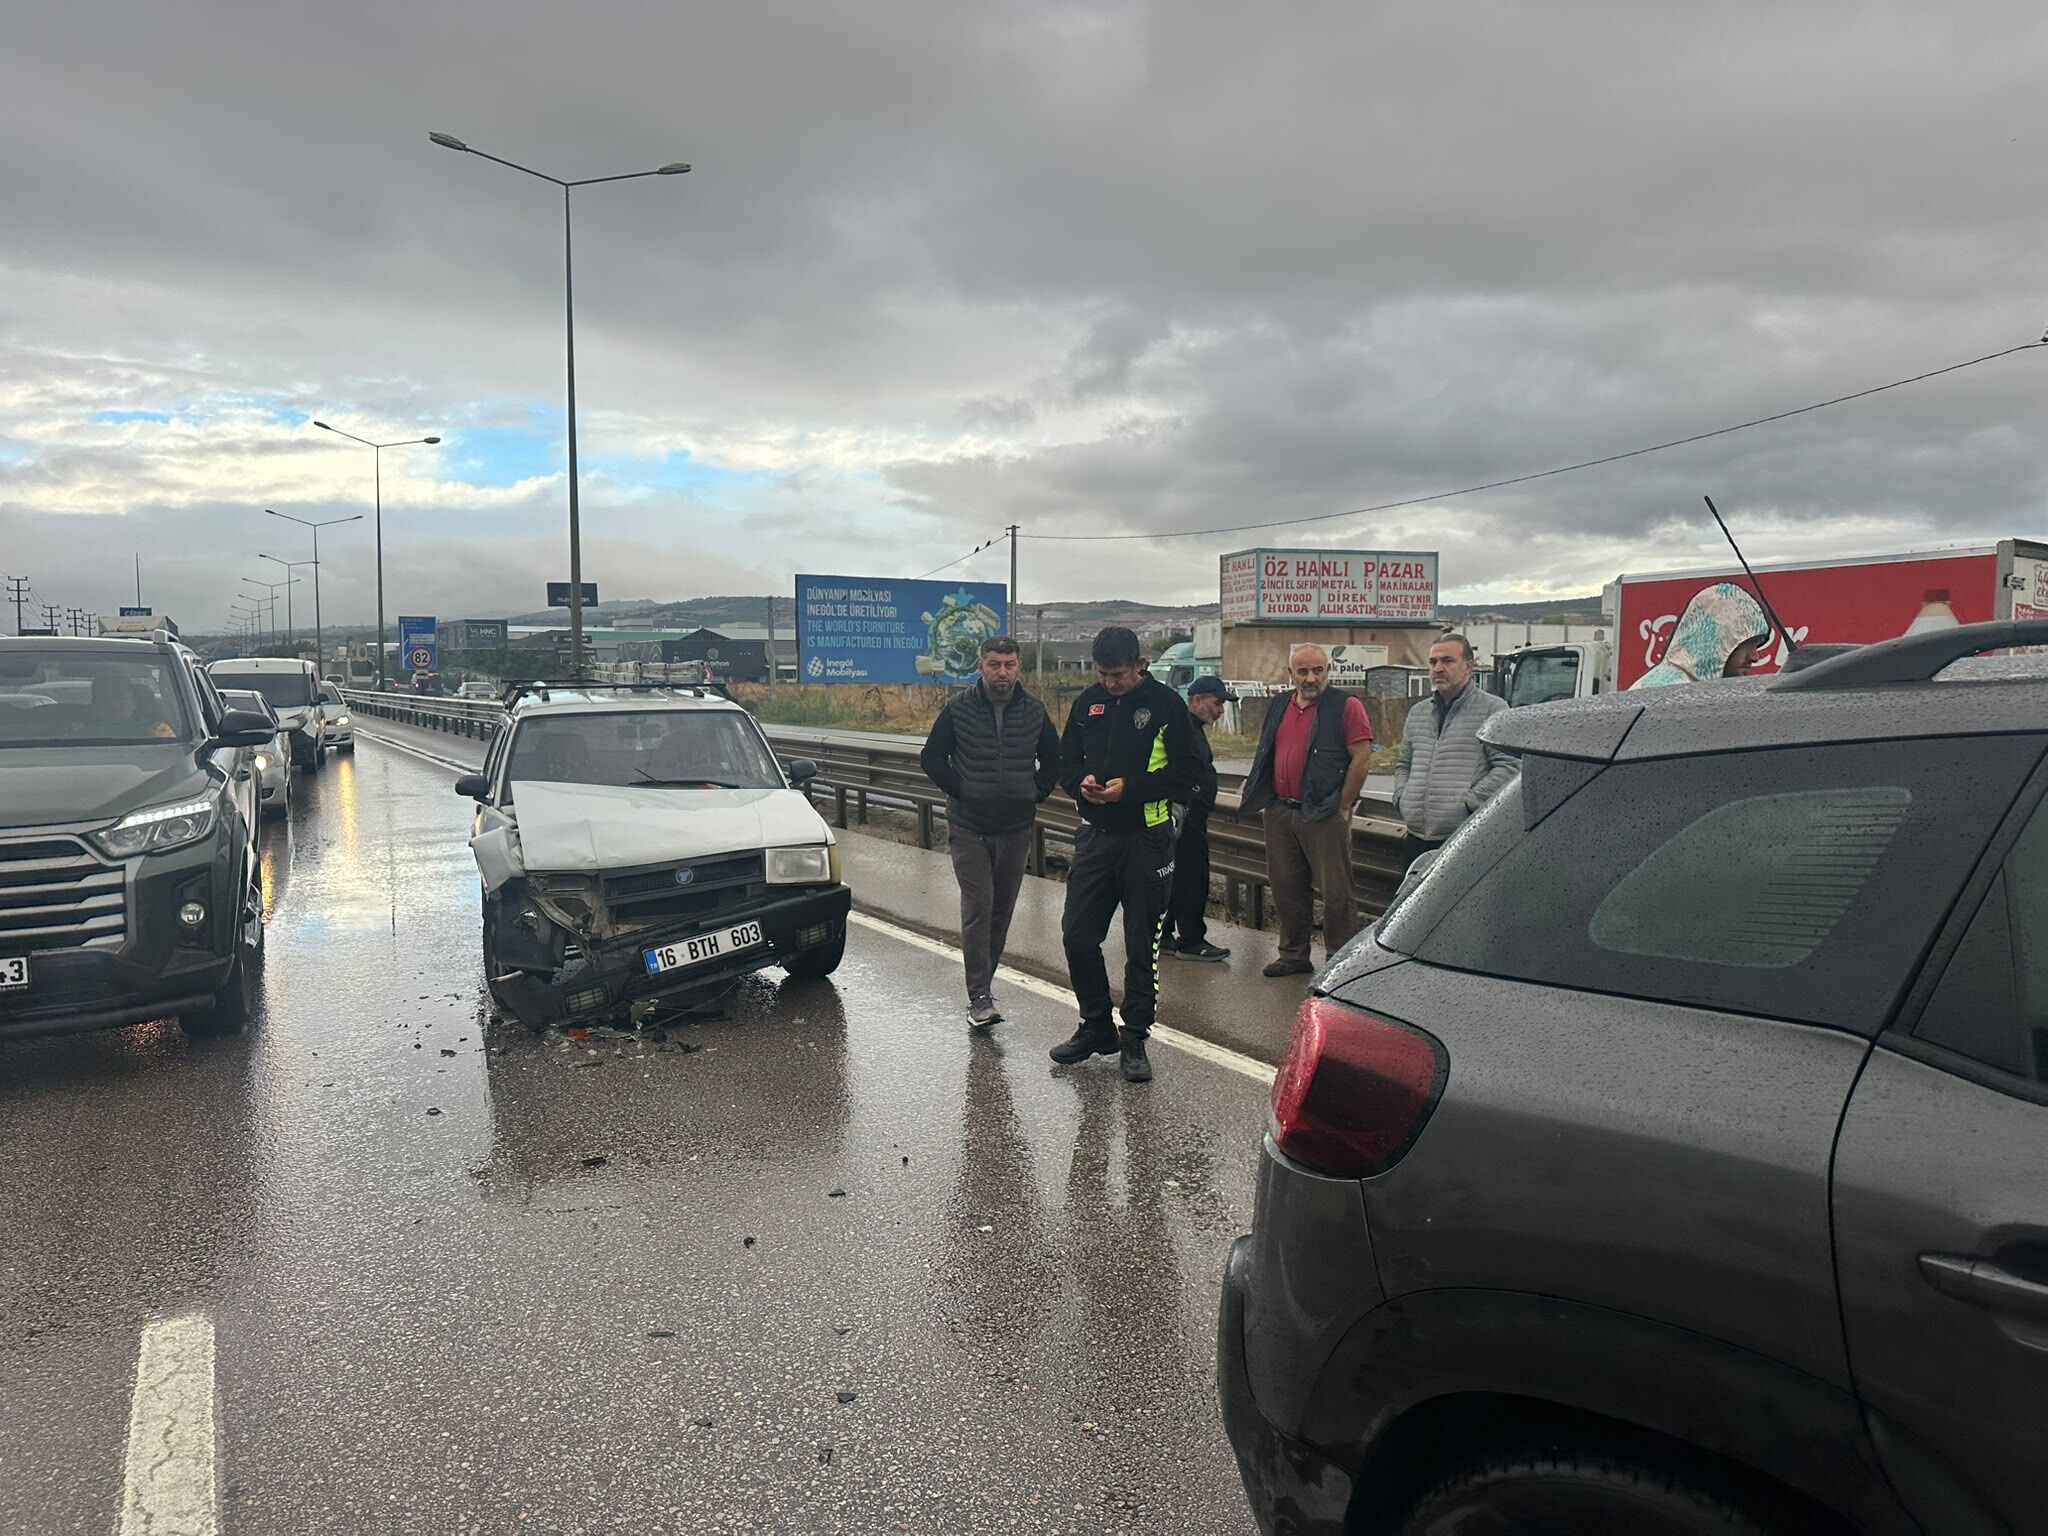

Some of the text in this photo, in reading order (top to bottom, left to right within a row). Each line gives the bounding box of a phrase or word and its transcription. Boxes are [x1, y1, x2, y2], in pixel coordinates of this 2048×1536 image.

[1264, 556, 1426, 579] ÖZ HANLI PAZAR
[1321, 580, 1358, 590] METAL
[1262, 593, 1313, 604] PLYWOOD
[1327, 590, 1368, 603] DİREK
[1379, 594, 1432, 605] KONTEYNIR
[807, 603, 848, 617] İNEGÖL'DE
[1267, 604, 1310, 614] HURDA
[1346, 604, 1377, 615] SATIM
[807, 620, 905, 634] THE WORLD'S FURNITURE
[817, 636, 882, 649] MANUFACTURED
[883, 637, 892, 649] IN
[414, 652, 429, 664] 82
[1340, 663, 1365, 674] palet
[657, 924, 761, 968] 16 BTH 603
